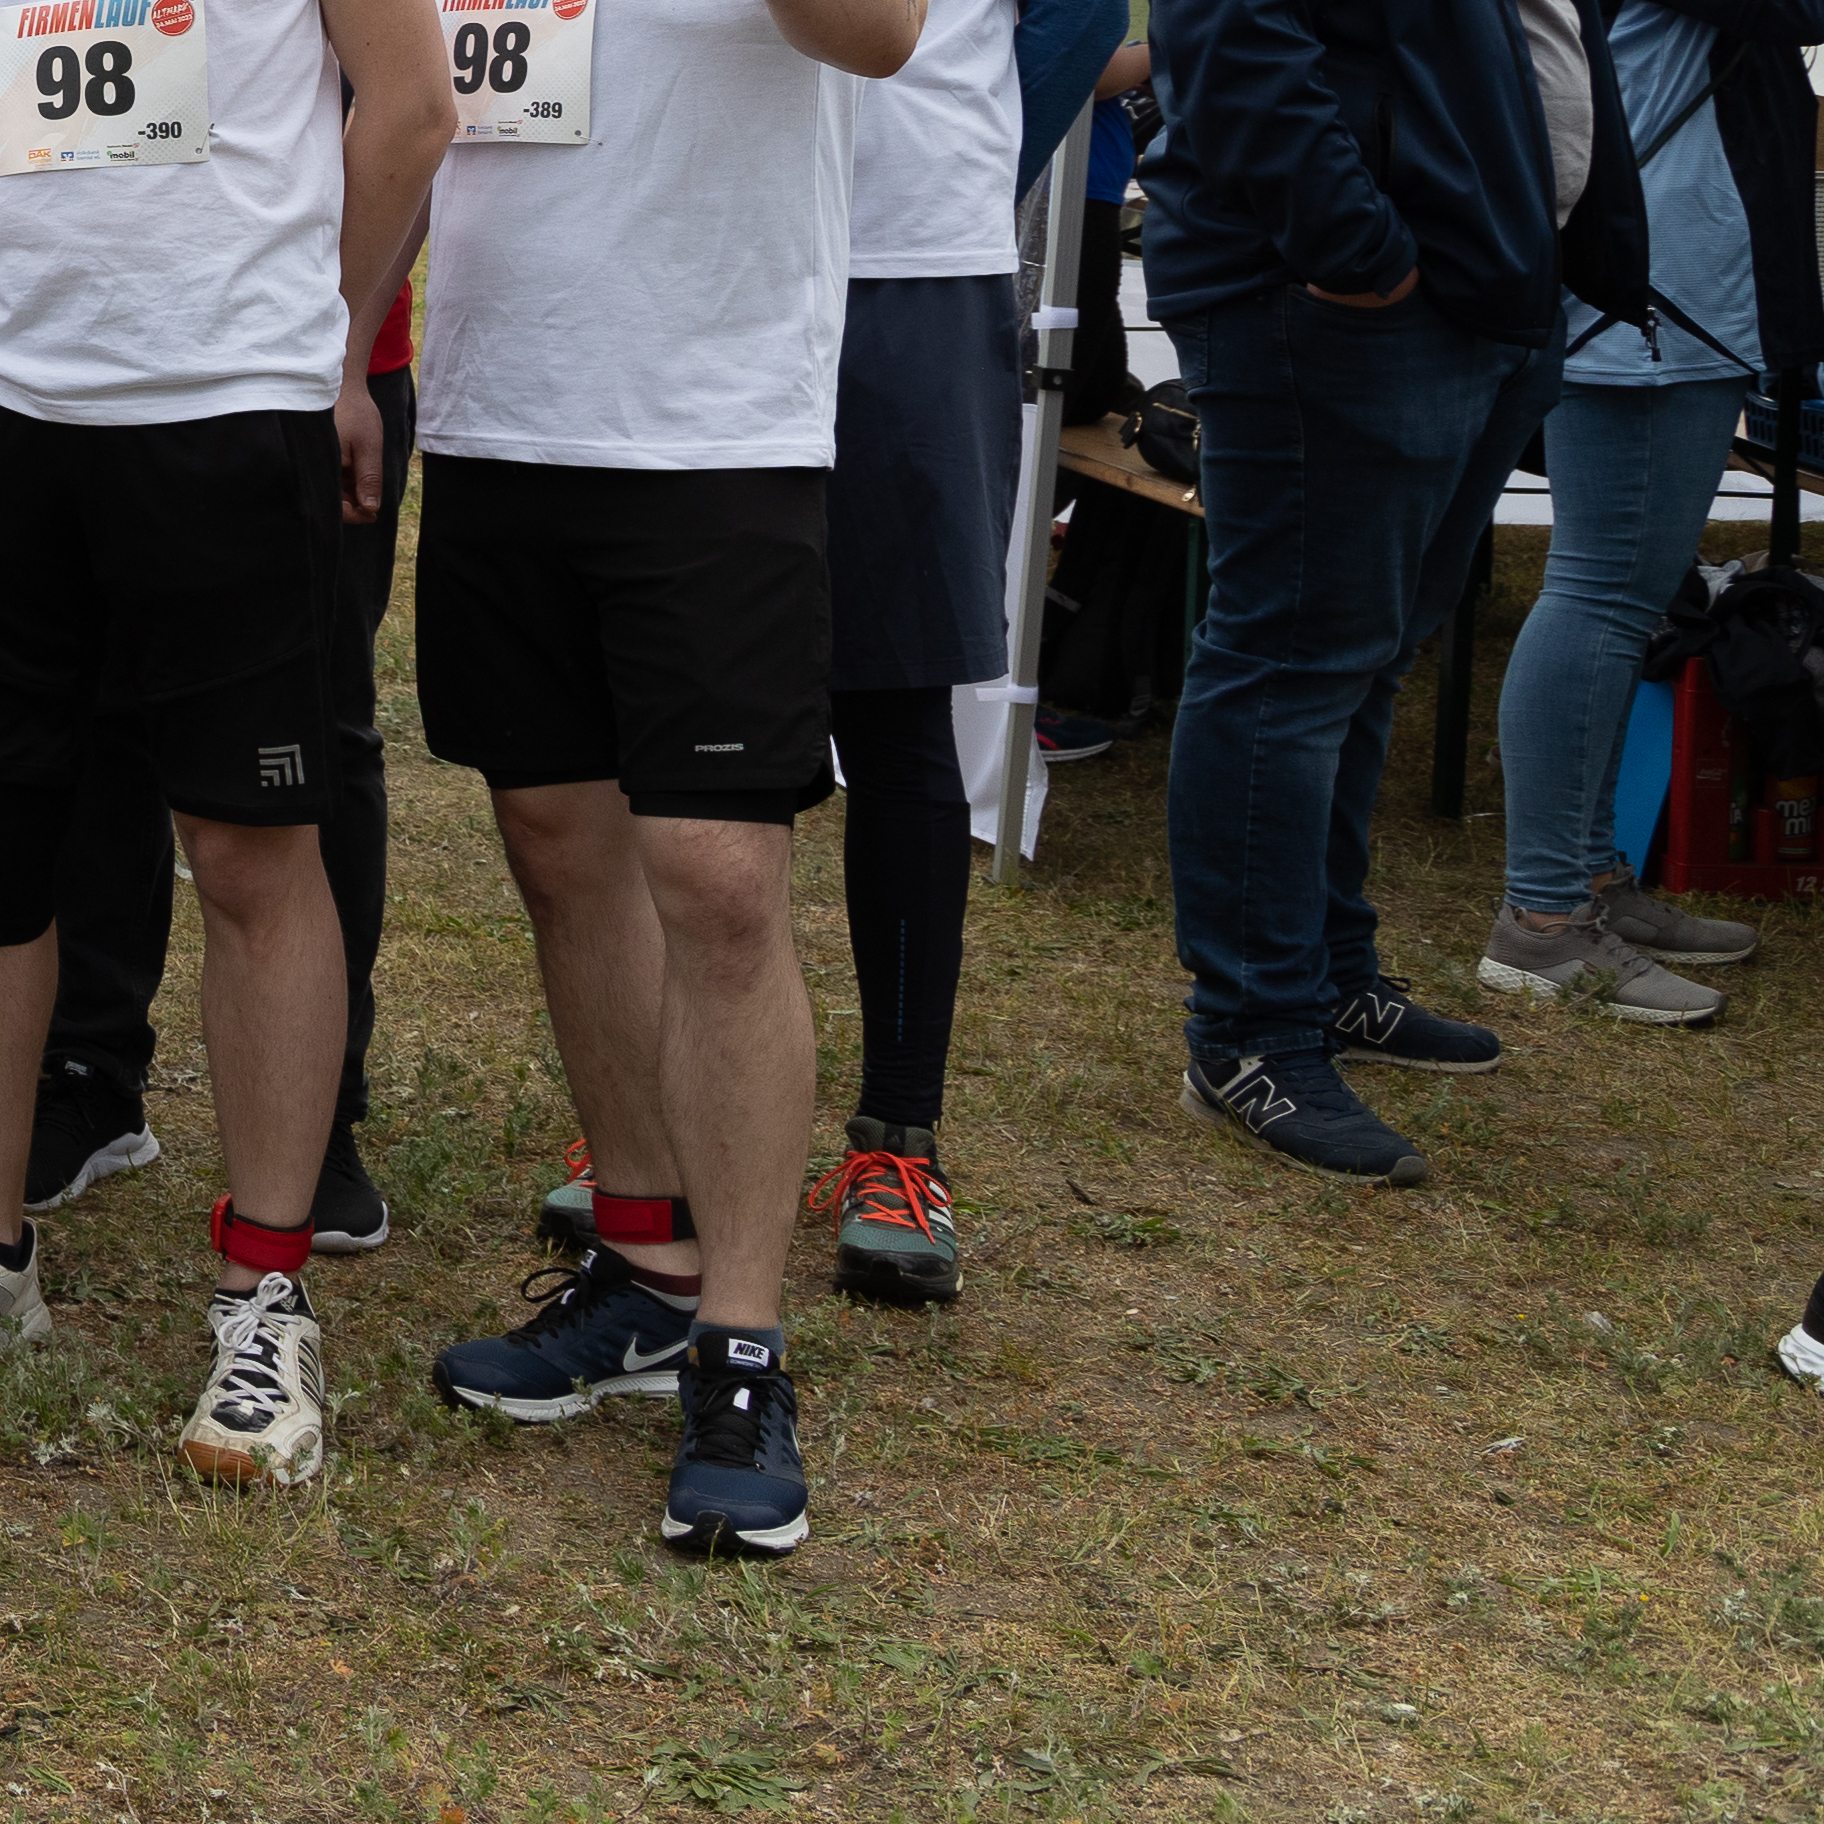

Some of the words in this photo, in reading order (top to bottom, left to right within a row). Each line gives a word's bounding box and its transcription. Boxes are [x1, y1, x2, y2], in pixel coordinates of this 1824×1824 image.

[453, 20, 531, 95] 98
[36, 40, 136, 121] 98
[523, 100, 563, 119] -389
[137, 120, 183, 140] -390
[694, 743, 745, 753] PROZIS
[733, 1342, 766, 1360] NIKE
